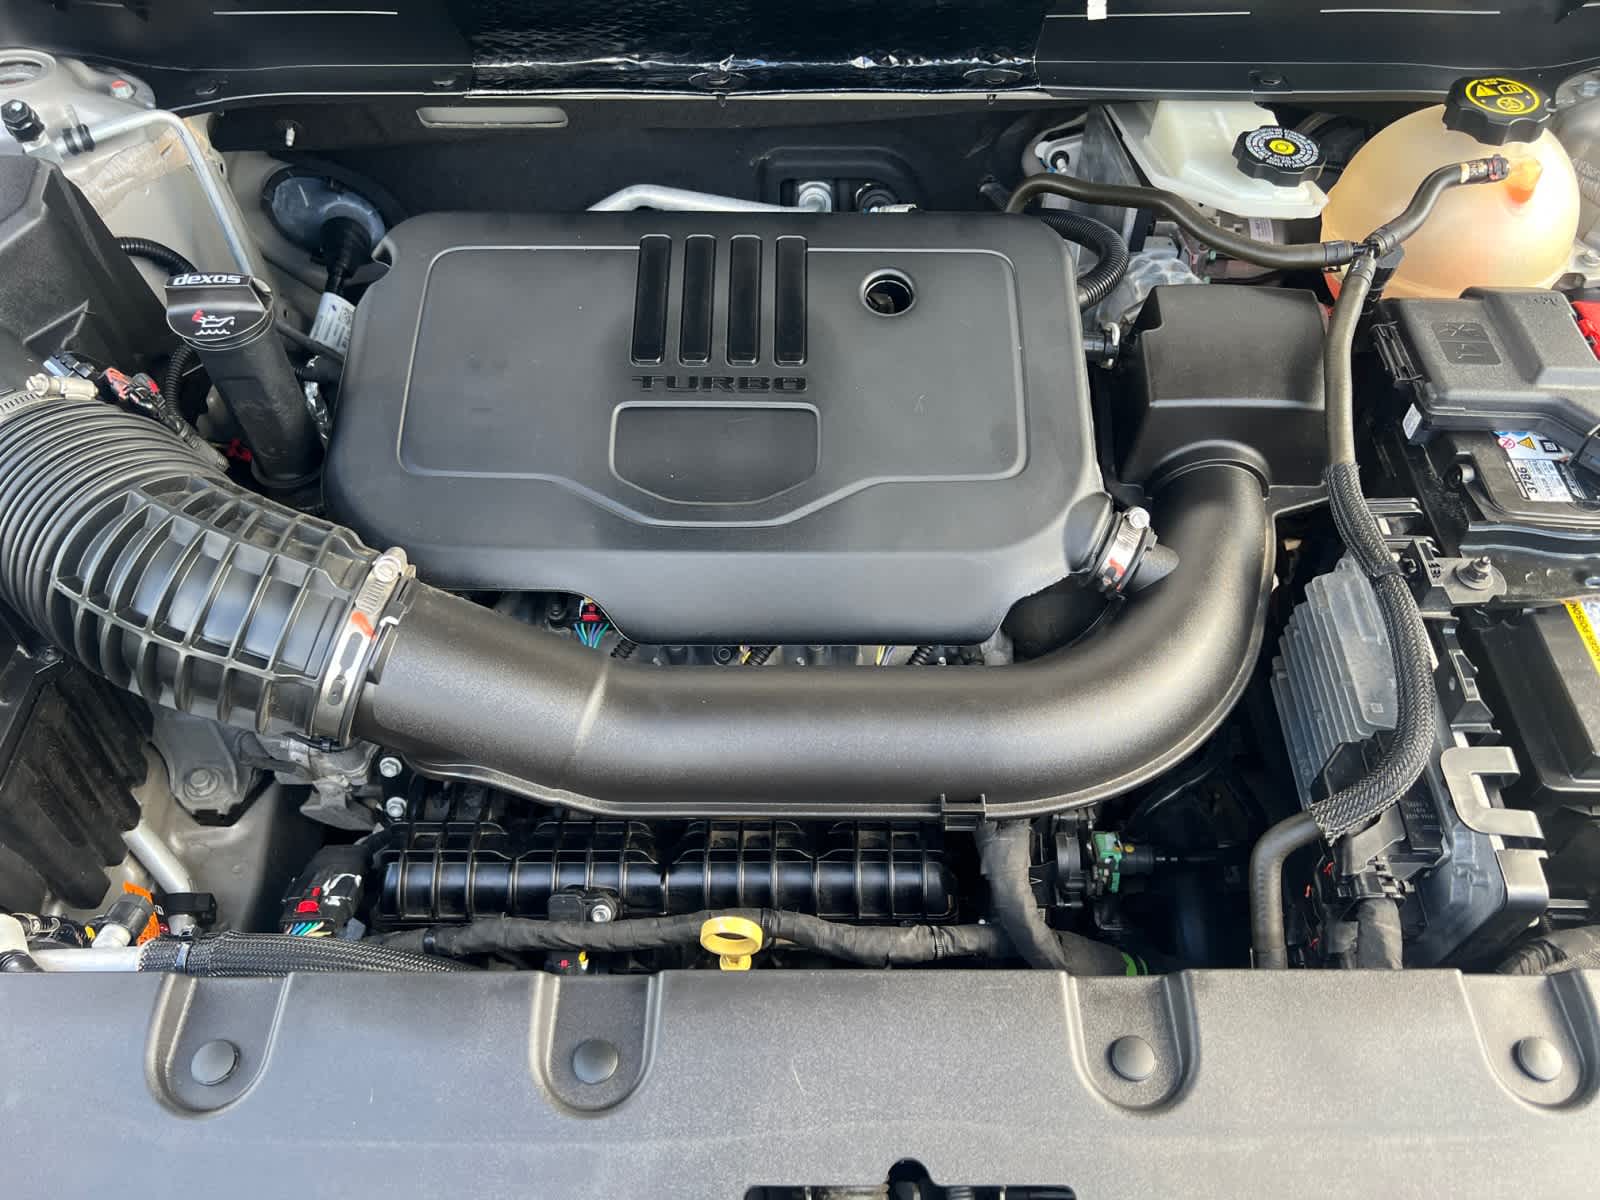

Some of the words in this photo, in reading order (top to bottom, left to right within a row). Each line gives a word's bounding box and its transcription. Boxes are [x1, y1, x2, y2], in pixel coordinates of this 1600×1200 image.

[173, 273, 244, 286] dexos
[632, 375, 807, 394] TURBO
[1517, 467, 1538, 493] 3786
